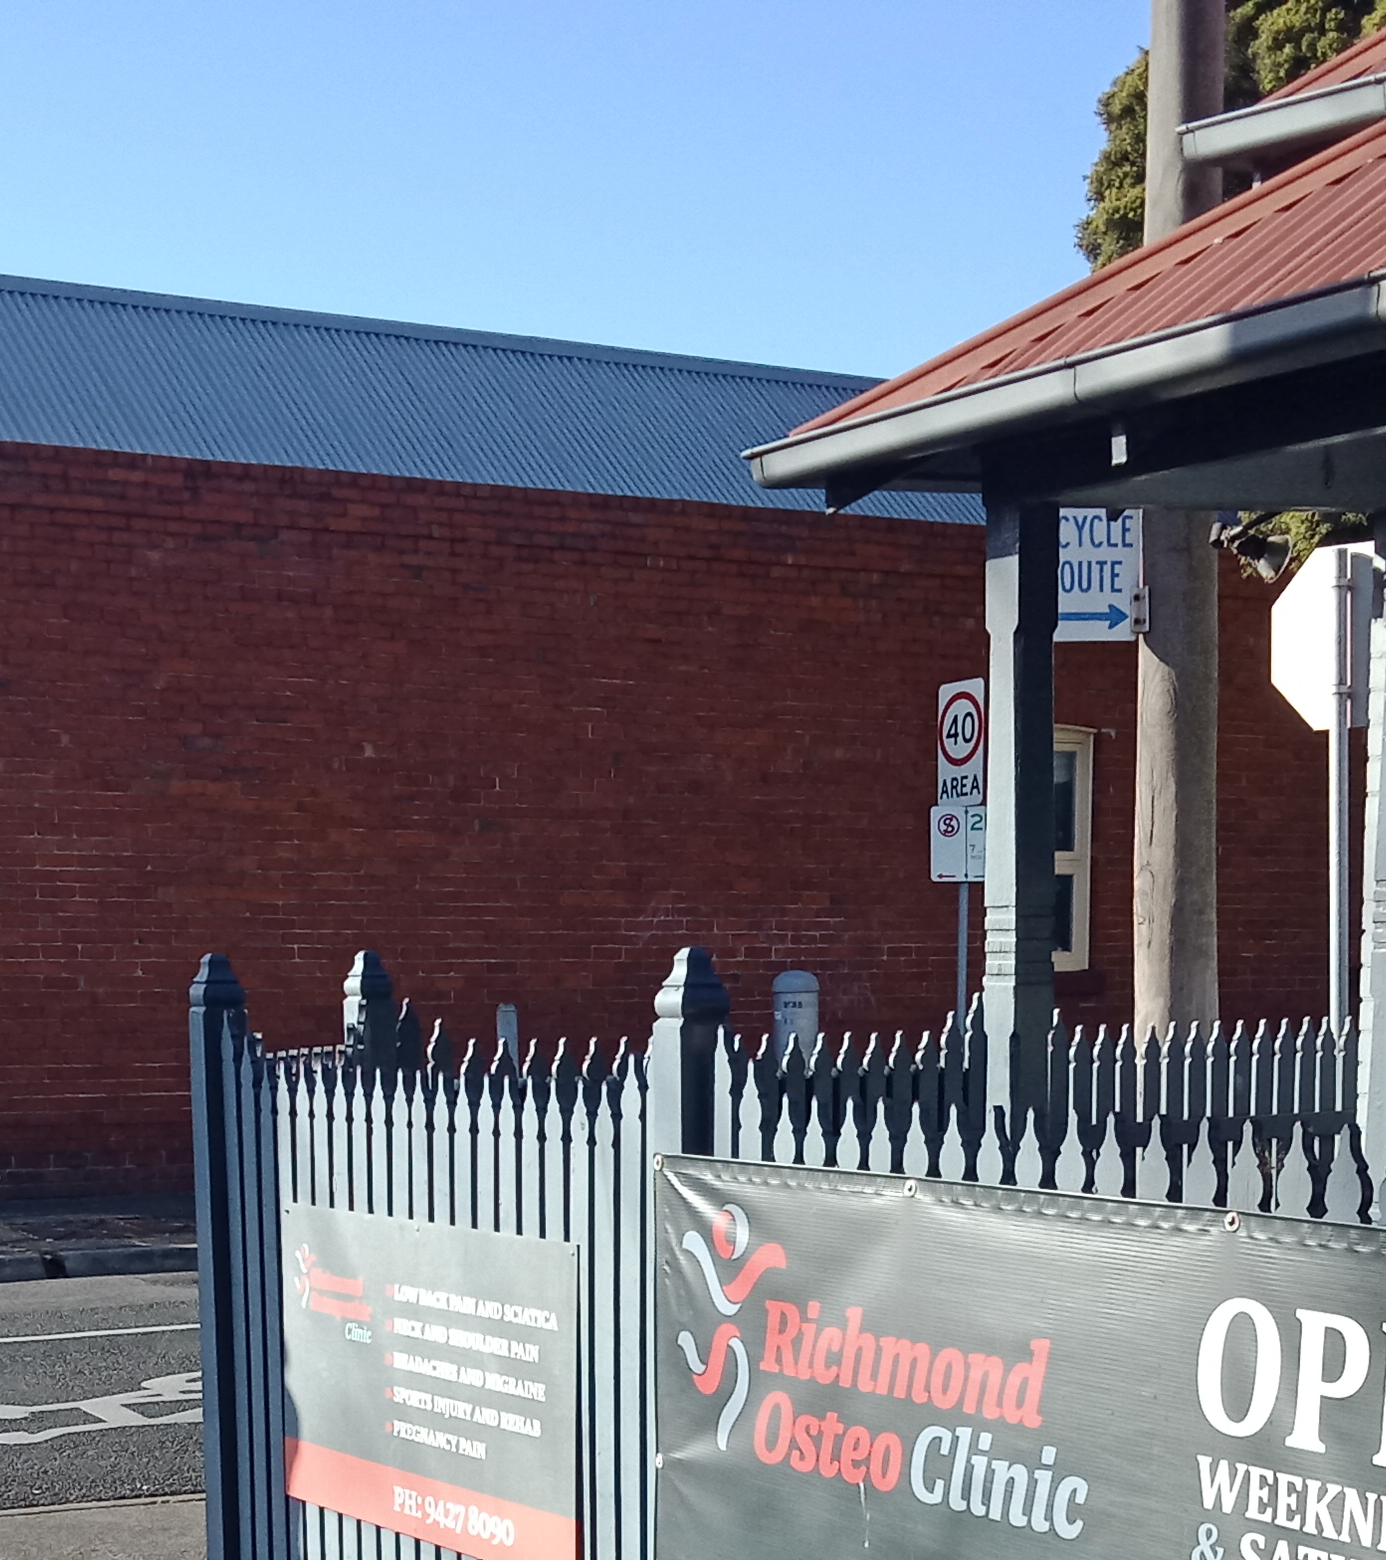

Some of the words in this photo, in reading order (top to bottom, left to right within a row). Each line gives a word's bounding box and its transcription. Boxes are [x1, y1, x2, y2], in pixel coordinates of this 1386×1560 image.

[1059, 514, 1134, 549] CYCLE
[1060, 560, 1123, 593] OUTE
[946, 711, 976, 746] 40
[940, 774, 981, 800] AREA
[970, 813, 987, 831] 2
[394, 1284, 419, 1303] LOW
[476, 1299, 502, 1320] AND
[503, 1304, 558, 1331] SCIATICA
[345, 1321, 373, 1344] Clinic
[423, 1323, 447, 1344] AND
[448, 1328, 509, 1358] SHOULDER
[510, 1340, 539, 1363] PAIN
[393, 1351, 458, 1382] HEADACHES
[459, 1366, 484, 1388] AND
[484, 1371, 546, 1402] MIGRAINE
[759, 1299, 1051, 1430] Richmond
[393, 1386, 432, 1410] SPORTS
[433, 1395, 473, 1418] INJURY
[473, 1406, 499, 1427] AND
[500, 1411, 541, 1438] REHAB
[393, 1420, 459, 1452] PREGNANCY
[458, 1437, 486, 1460] PAIN
[752, 1391, 904, 1493] Osteo
[909, 1425, 1089, 1541] Clinic
[393, 1485, 423, 1520] PH:
[424, 1494, 466, 1535] 9427
[467, 1504, 515, 1547] 8090
